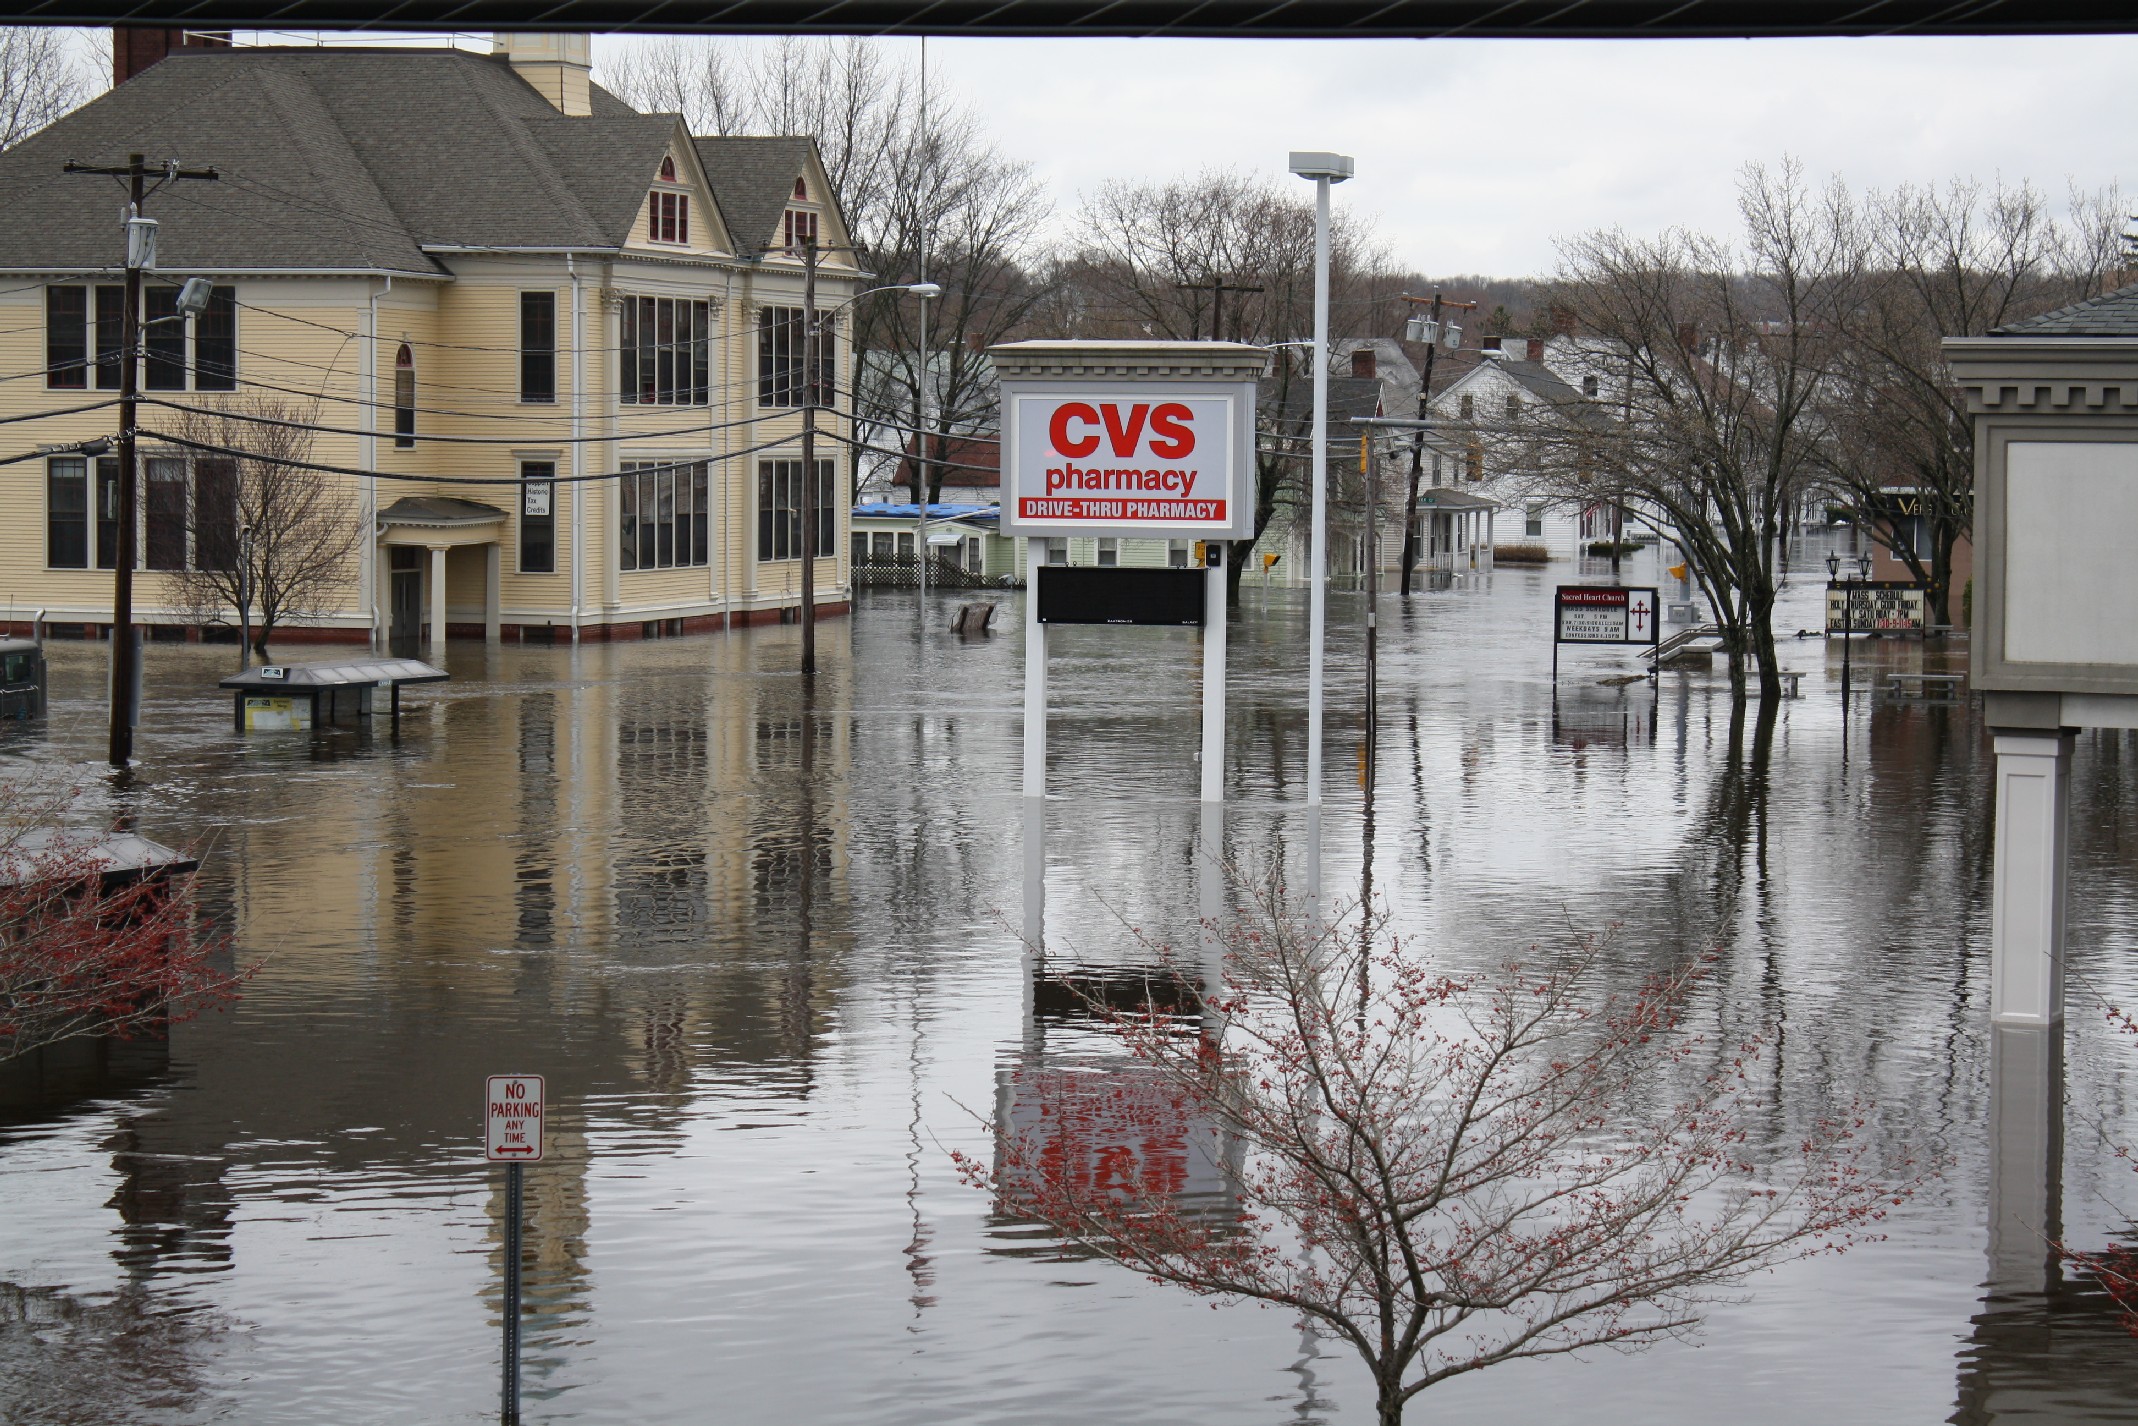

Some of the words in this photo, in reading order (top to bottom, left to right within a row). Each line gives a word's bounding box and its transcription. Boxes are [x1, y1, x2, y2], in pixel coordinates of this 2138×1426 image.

[1049, 402, 1195, 459] CVS
[1046, 463, 1197, 498] pharmacy
[1026, 500, 1123, 517] DRIVE-THRU
[1127, 502, 1218, 519] PHARMACY
[1561, 593, 1582, 601] Sacred
[1583, 593, 1601, 601] Heart
[1852, 591, 1869, 600] MASS
[1875, 591, 1904, 600] SCHEDULE
[505, 1083, 526, 1099] NO
[491, 1102, 539, 1118] PARKING
[505, 1120, 525, 1130] ANY
[504, 1132, 526, 1143] TIME
